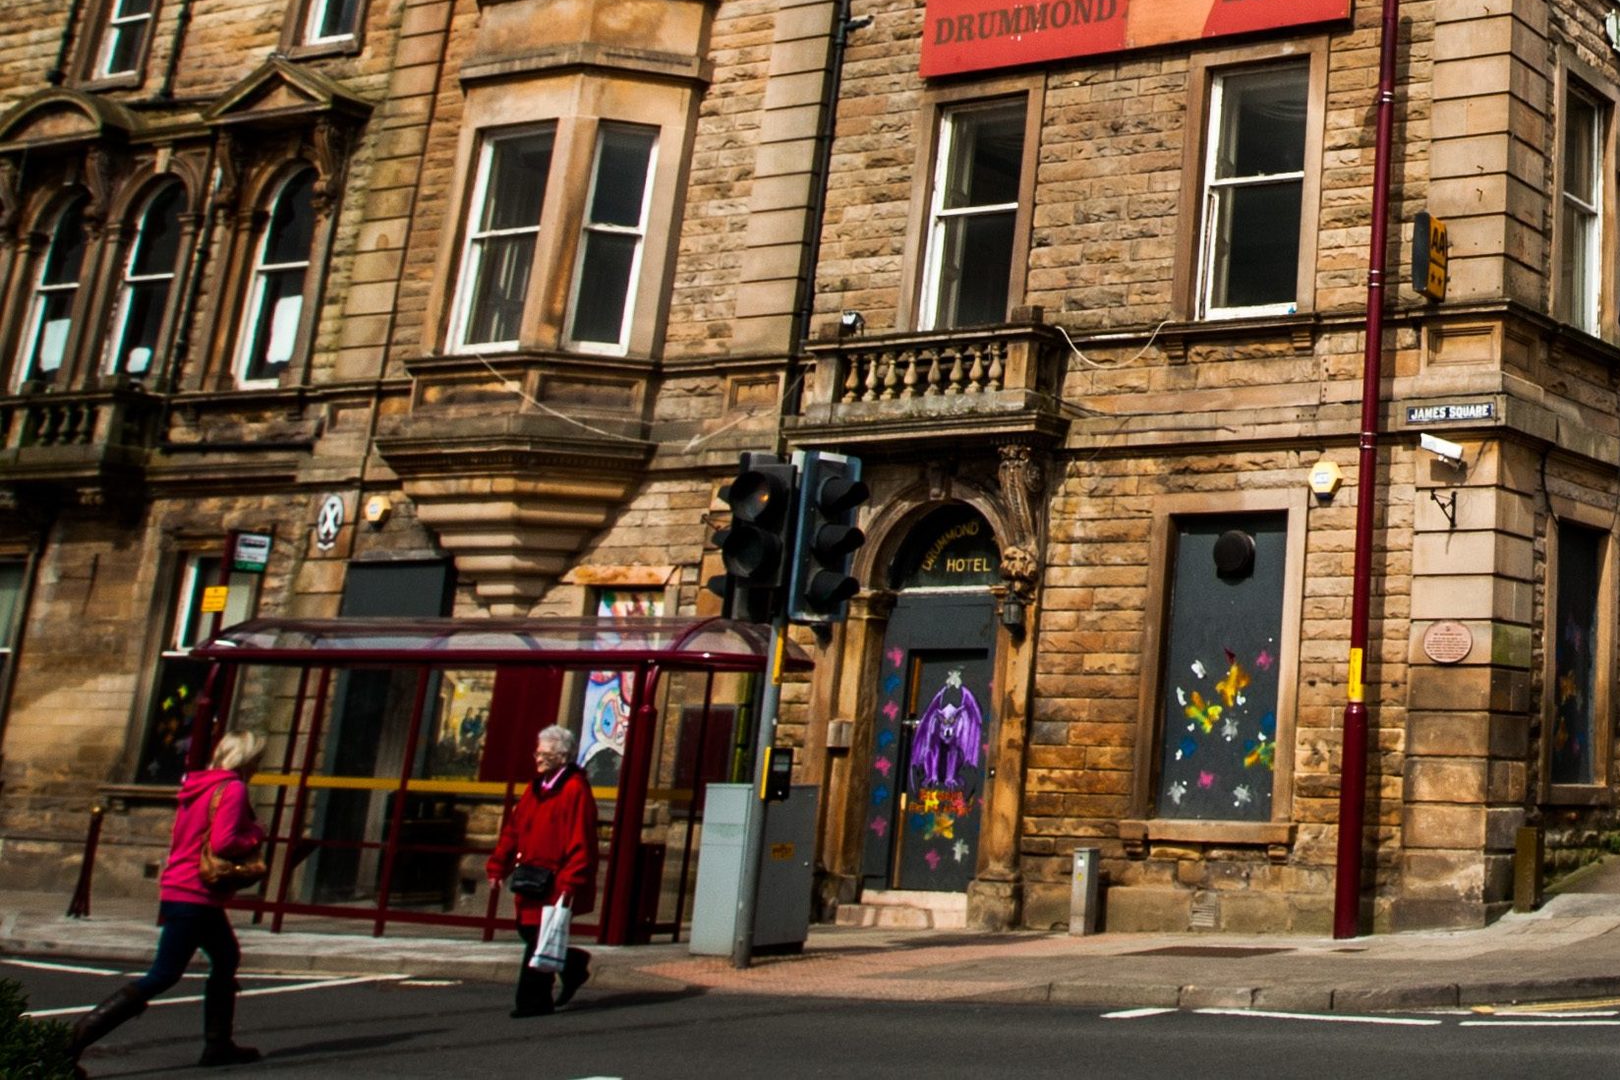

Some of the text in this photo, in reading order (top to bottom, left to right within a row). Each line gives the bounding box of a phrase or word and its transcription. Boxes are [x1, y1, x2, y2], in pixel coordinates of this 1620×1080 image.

[1411, 403, 1489, 420] JAMES SQUARE
[922, 521, 980, 571] DRUMMOND
[946, 558, 992, 572] HOTEL
